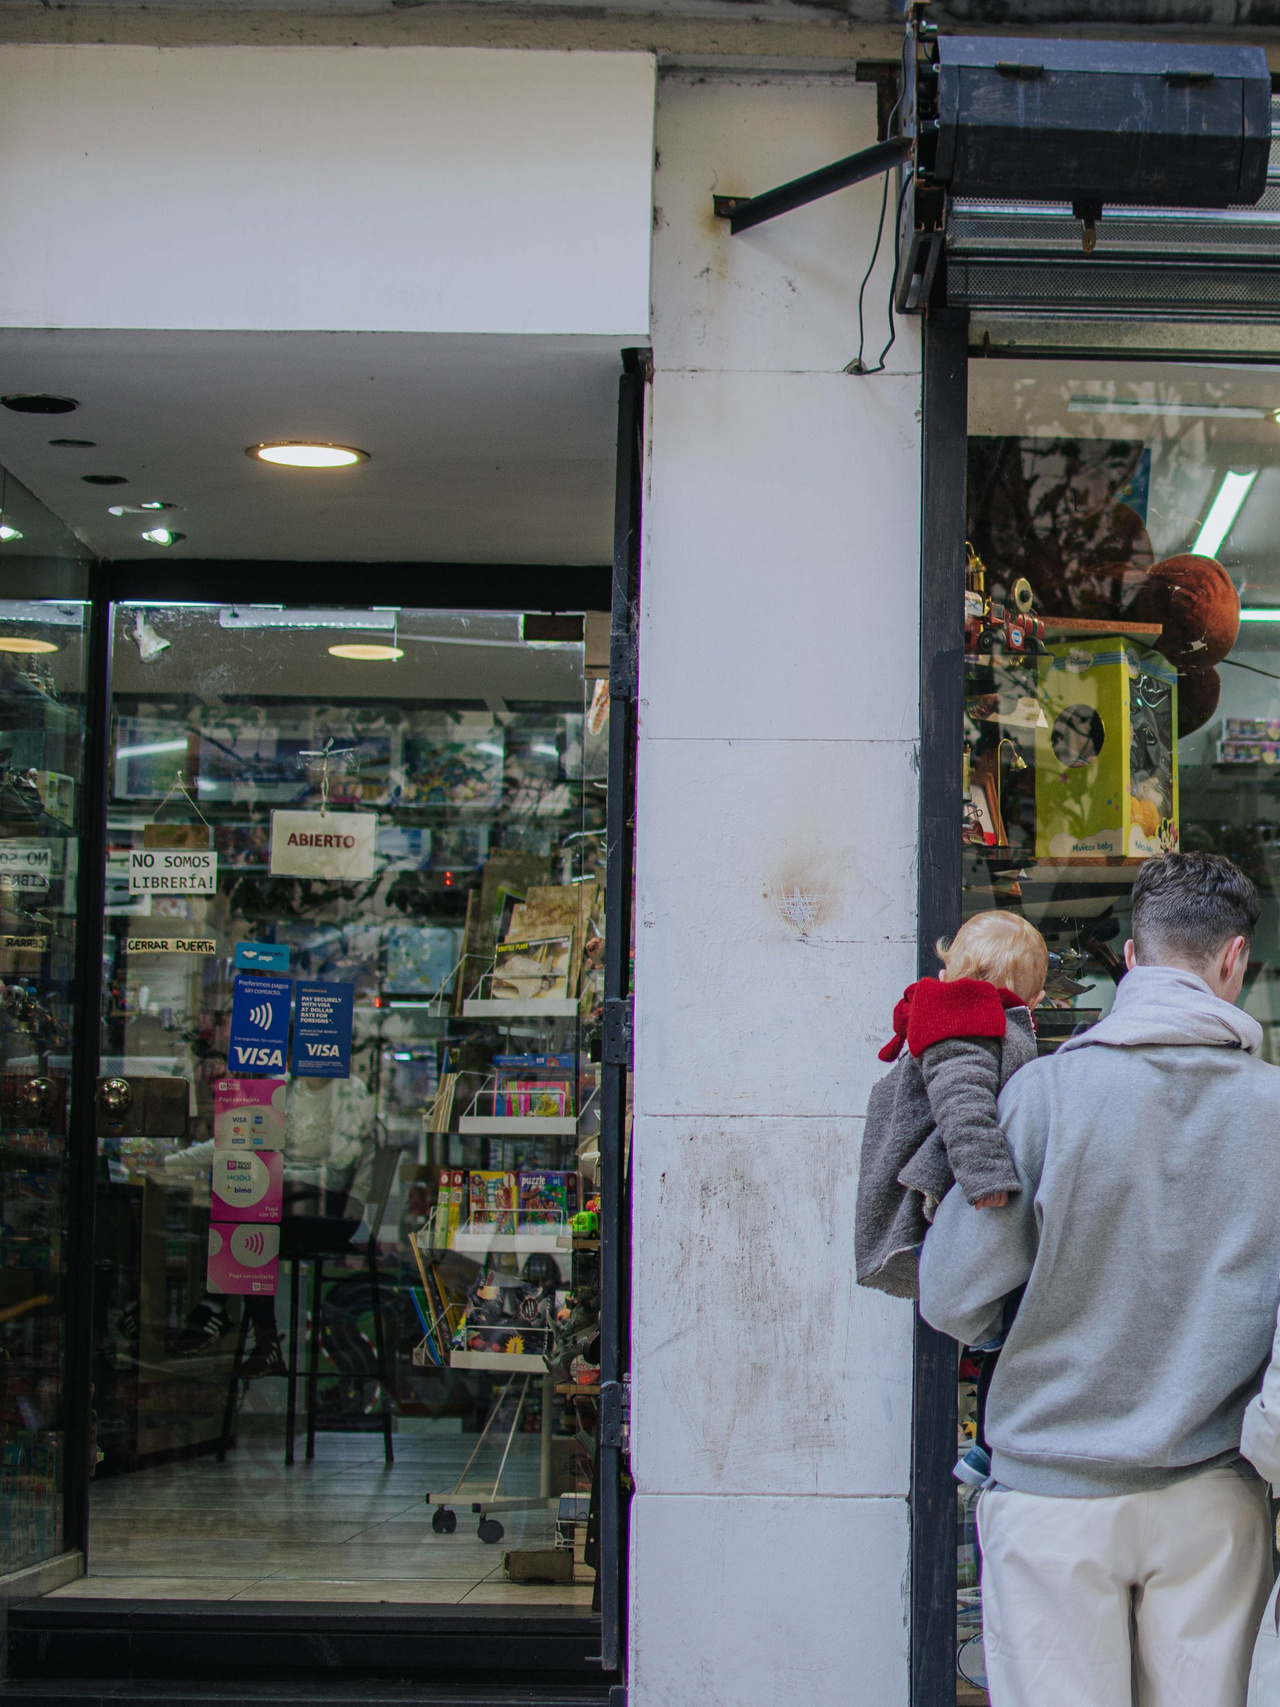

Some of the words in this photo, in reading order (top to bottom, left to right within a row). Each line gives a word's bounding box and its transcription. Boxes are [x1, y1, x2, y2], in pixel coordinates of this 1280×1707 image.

[1068, 657, 1091, 667] Disney
[287, 832, 356, 850] ABIERTO
[132, 854, 155, 868] NO
[164, 856, 210, 868] SOMOS
[132, 874, 214, 889] LIBRERÍA!
[128, 940, 169, 950] CERRAR
[176, 940, 215, 952] PUERTA
[238, 980, 271, 988] Preferimos
[271, 982, 289, 990] pagos
[233, 1046, 283, 1067] VISA
[305, 1043, 340, 1057] VISA
[521, 1175, 546, 1187] puzzle
[234, 1186, 252, 1194] bimo
